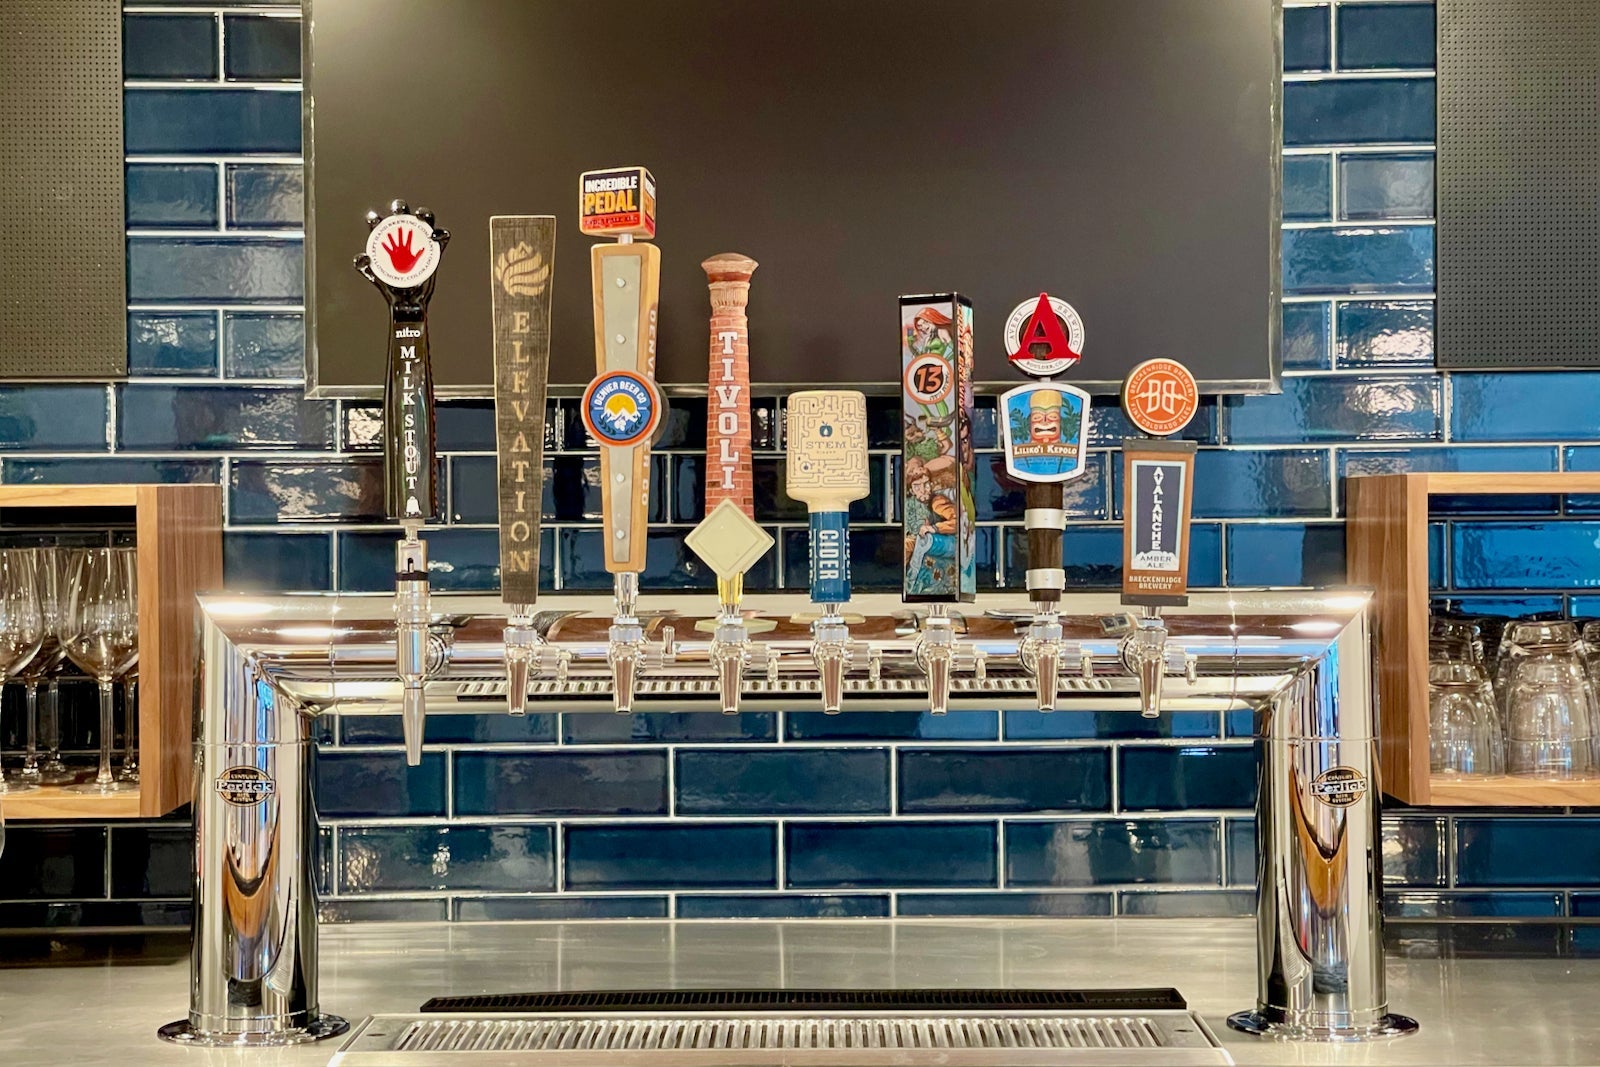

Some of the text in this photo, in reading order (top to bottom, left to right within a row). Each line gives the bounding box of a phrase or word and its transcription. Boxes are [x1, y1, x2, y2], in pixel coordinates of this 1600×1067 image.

[585, 176, 638, 193] INCREDIBLE
[584, 189, 637, 215] PEDAL
[375, 223, 389, 241] HAND
[388, 219, 417, 227] BREWING
[406, 257, 433, 280] COLORADO
[395, 326, 421, 338] nitro
[1009, 305, 1080, 346] AVERY BREWING
[917, 365, 942, 392] 13
[1130, 363, 1194, 397] BRECKENRIDGE BREWERY
[594, 381, 647, 405] DENVER BEER CO
[400, 345, 417, 490] MILK STOUT
[715, 331, 741, 489] TIVOLI
[1130, 402, 1192, 430] FINE COLORADO ALES
[510, 311, 531, 572] ELEVATION
[1047, 445, 1077, 455] KEPOLO
[1152, 466, 1164, 550] AVALANCHE
[819, 529, 839, 579] CIDER
[1128, 575, 1182, 583] BRECKENRIDGE
[1313, 780, 1365, 793] Perlick
